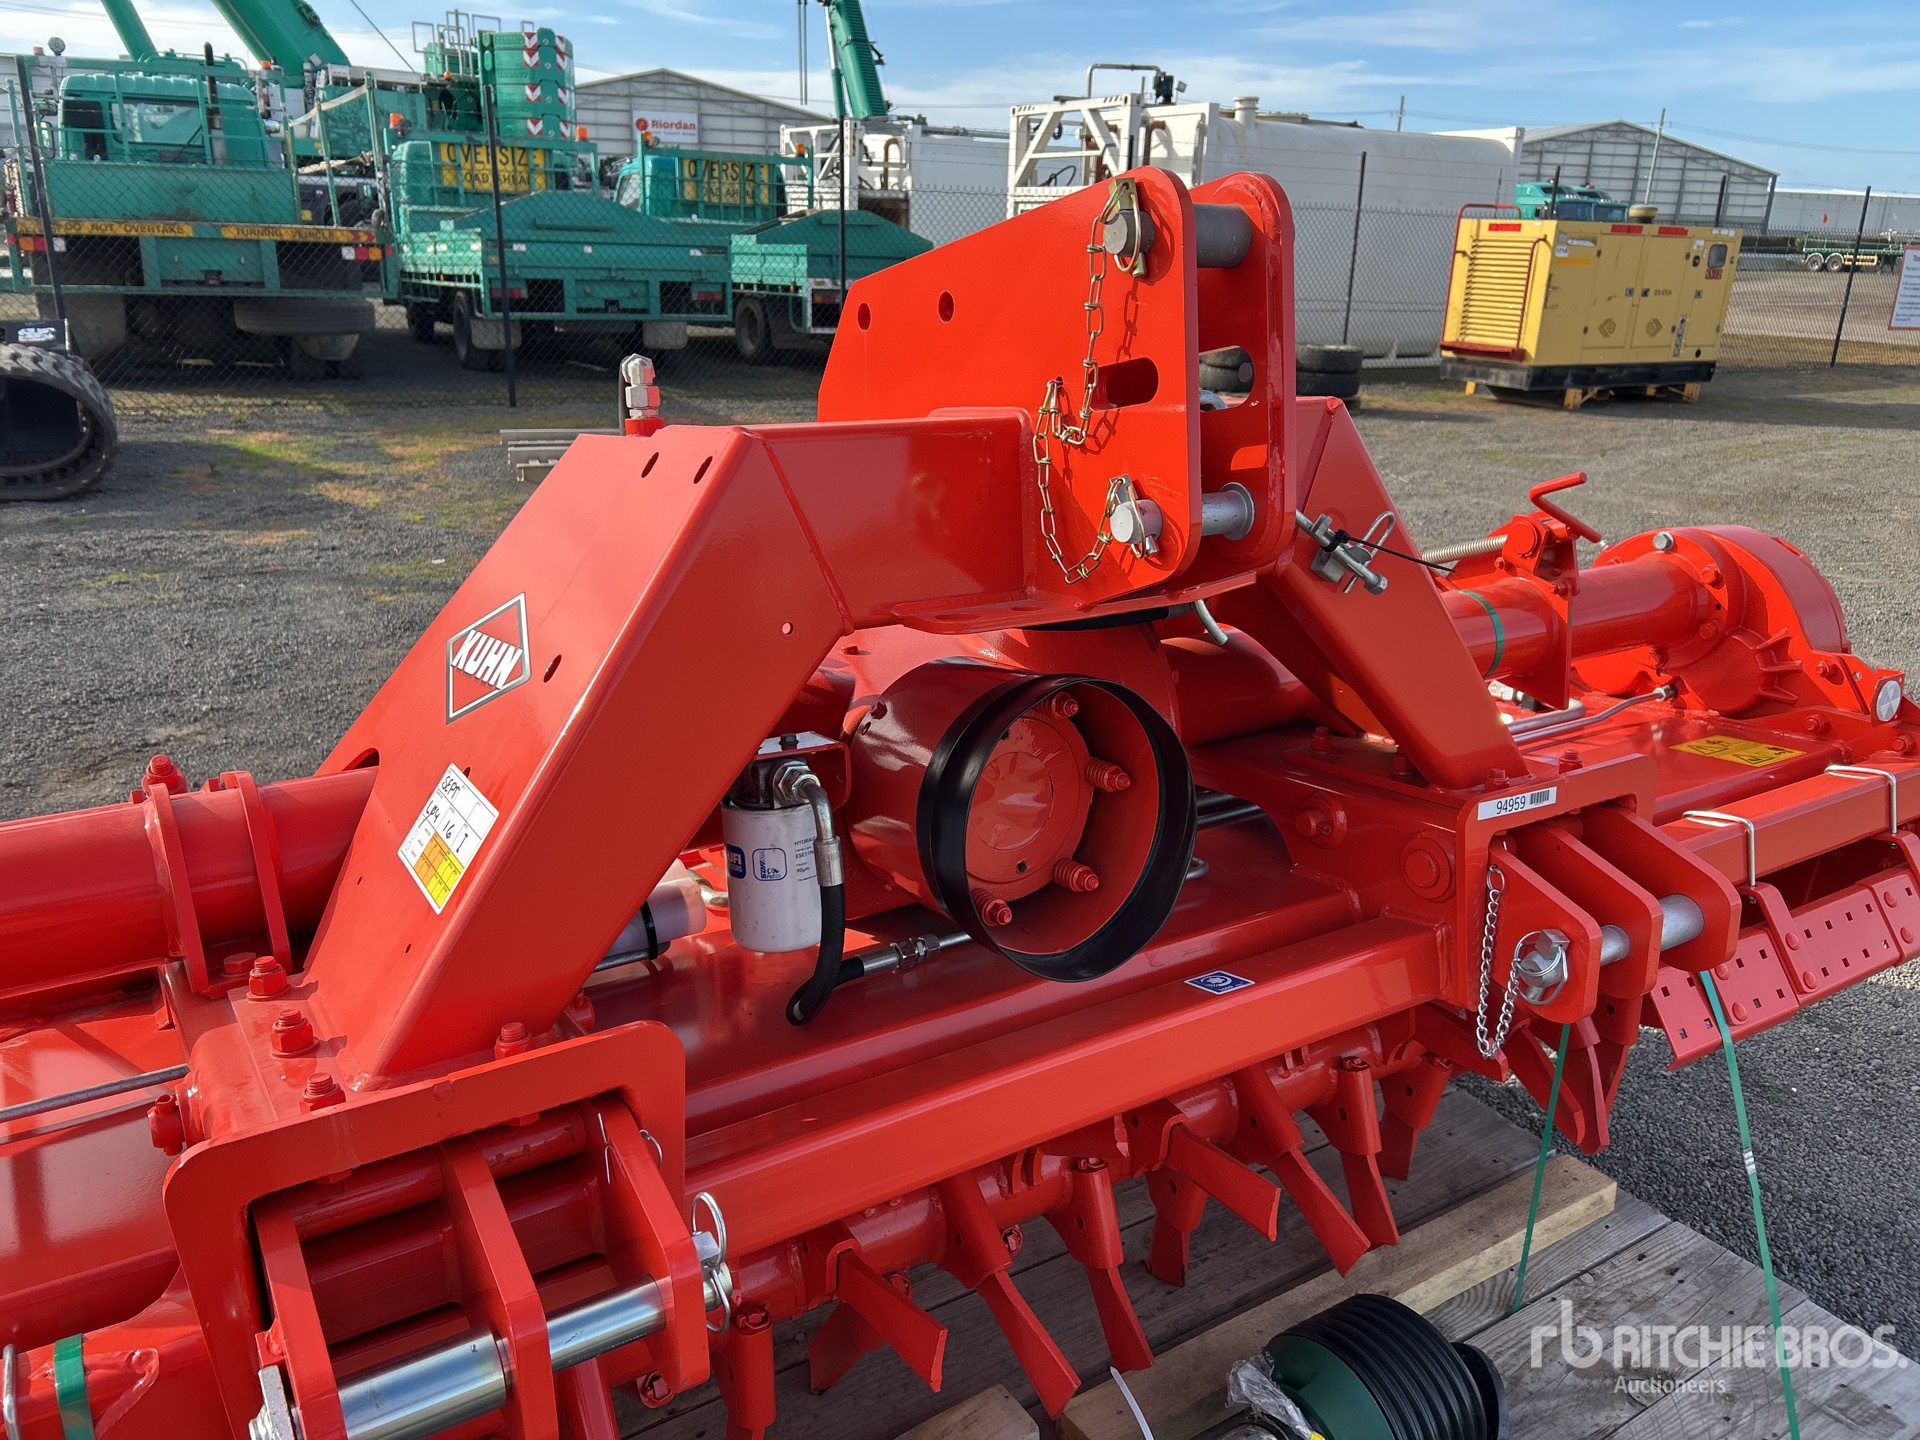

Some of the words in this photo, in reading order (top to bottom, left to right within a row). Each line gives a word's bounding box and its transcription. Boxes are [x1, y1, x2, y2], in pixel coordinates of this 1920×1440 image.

[651, 119, 696, 130] Riordan
[64, 222, 82, 231] DO
[91, 222, 114, 232] NOT
[123, 223, 185, 235] OVERTAKE
[236, 226, 283, 239] TURNING
[450, 629, 523, 690] KUHN
[1496, 795, 1526, 815] 94959
